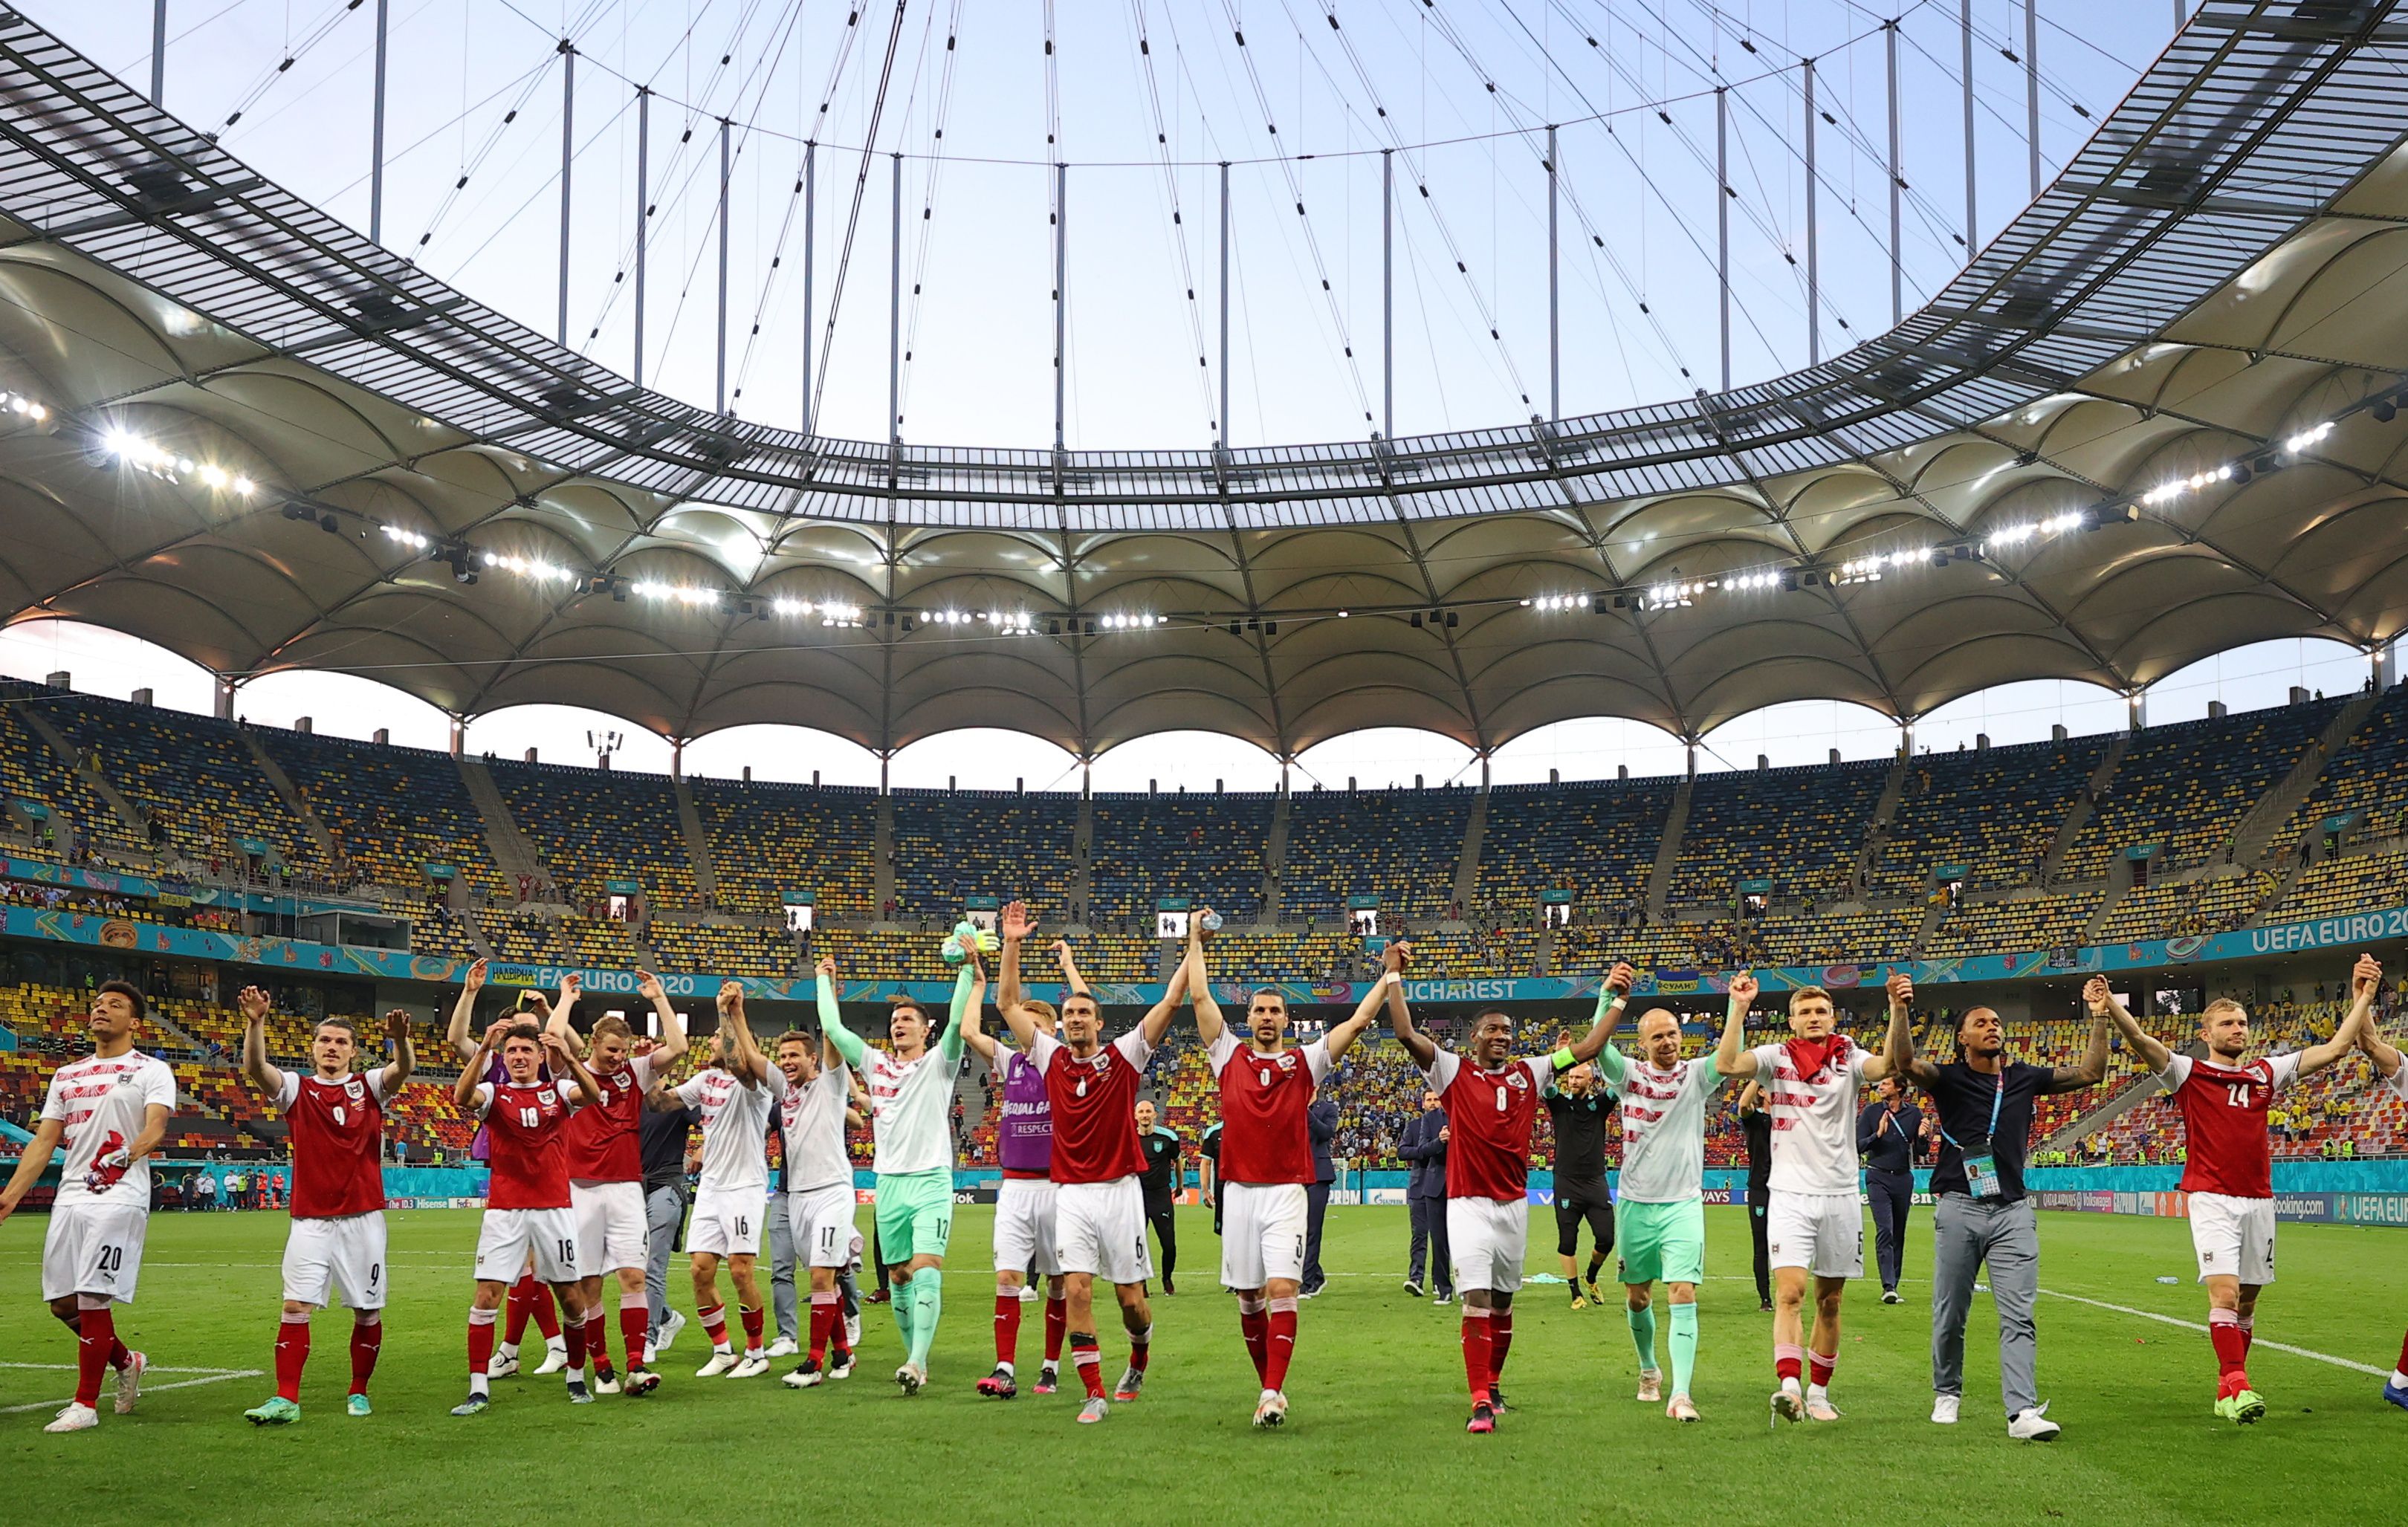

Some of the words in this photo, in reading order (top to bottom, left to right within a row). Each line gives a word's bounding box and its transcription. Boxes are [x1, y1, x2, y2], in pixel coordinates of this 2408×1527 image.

[2252, 923, 2316, 952] UEFA
[2320, 914, 2384, 944] EURO
[1404, 980, 1518, 1000] UCHAREST
[1496, 1086, 1507, 1111] 8
[2227, 1083, 2250, 1108] 24
[333, 1106, 345, 1126] 9
[520, 1106, 539, 1127] 18
[1036, 1100, 1050, 1115] GA
[1017, 1124, 1053, 1134] RESPECT
[417, 1197, 447, 1209] Hisense
[456, 1199, 472, 1207] FedEx
[953, 1193, 974, 1203] Tok
[1329, 1190, 1360, 1205] PROM
[2082, 1192, 2111, 1210] Volkswagen
[2273, 1195, 2324, 1219] Booking.com
[2353, 1196, 2386, 1221] UEFA
[734, 1216, 748, 1236] 16
[936, 1218, 948, 1240] 12
[643, 1230, 648, 1251] 4
[821, 1227, 835, 1247] 17
[1136, 1236, 1143, 1259] 6
[1296, 1234, 1303, 1259] 3
[97, 1245, 123, 1271] 20
[557, 1239, 574, 1262] 18
[370, 1263, 379, 1286] 9
